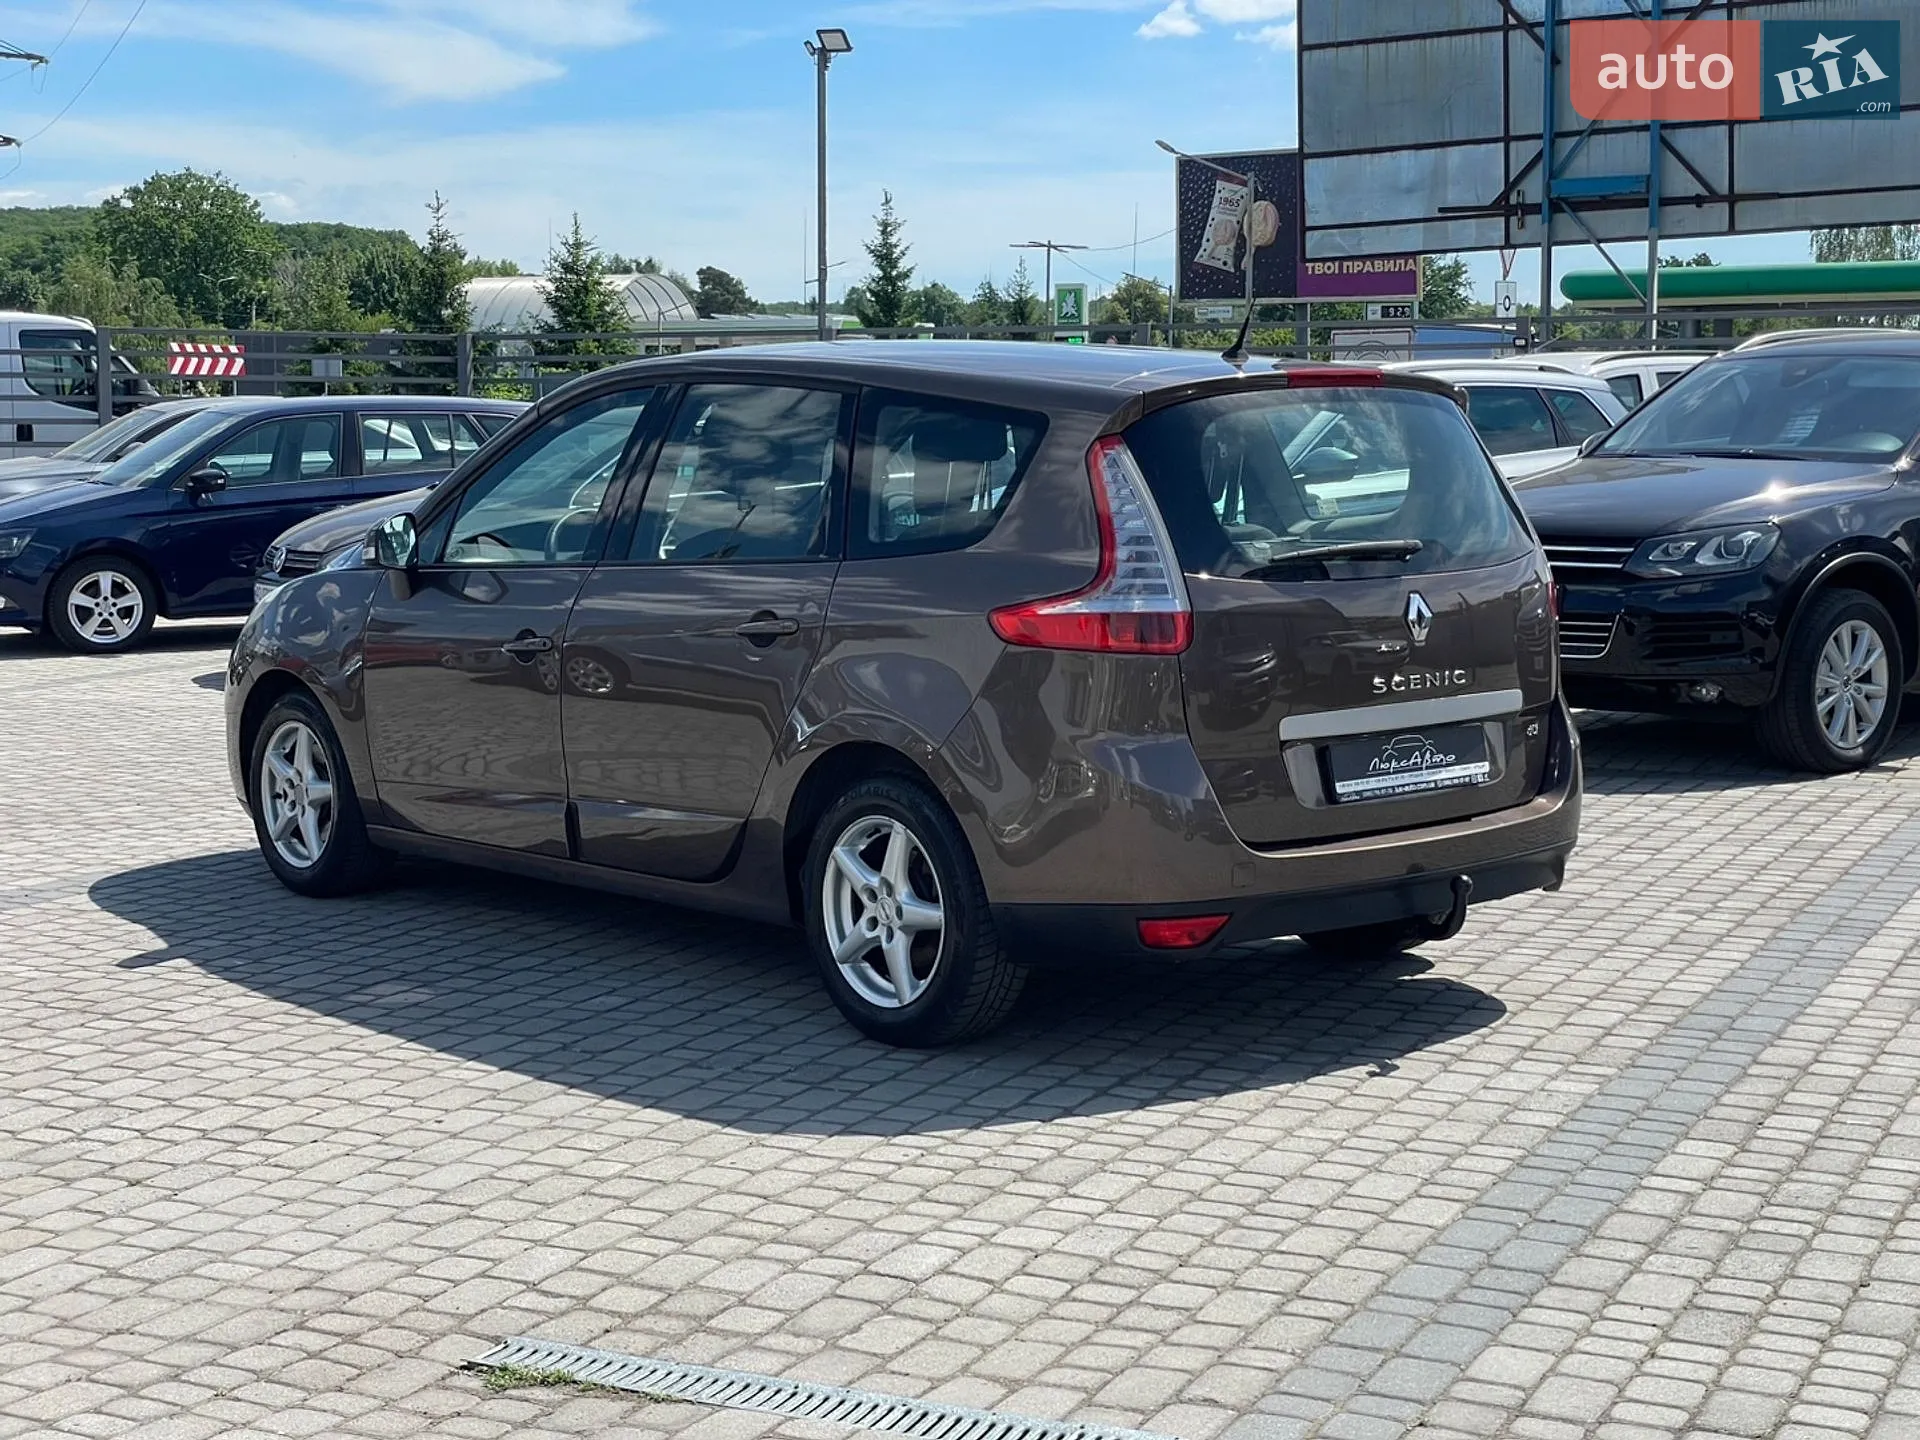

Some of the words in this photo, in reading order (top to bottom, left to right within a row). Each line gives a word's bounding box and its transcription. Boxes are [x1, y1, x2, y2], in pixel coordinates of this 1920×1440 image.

[1218, 196, 1241, 208] 1965
[1343, 259, 1417, 274] ПРАВИЛА
[1372, 669, 1467, 694] SCENIC
